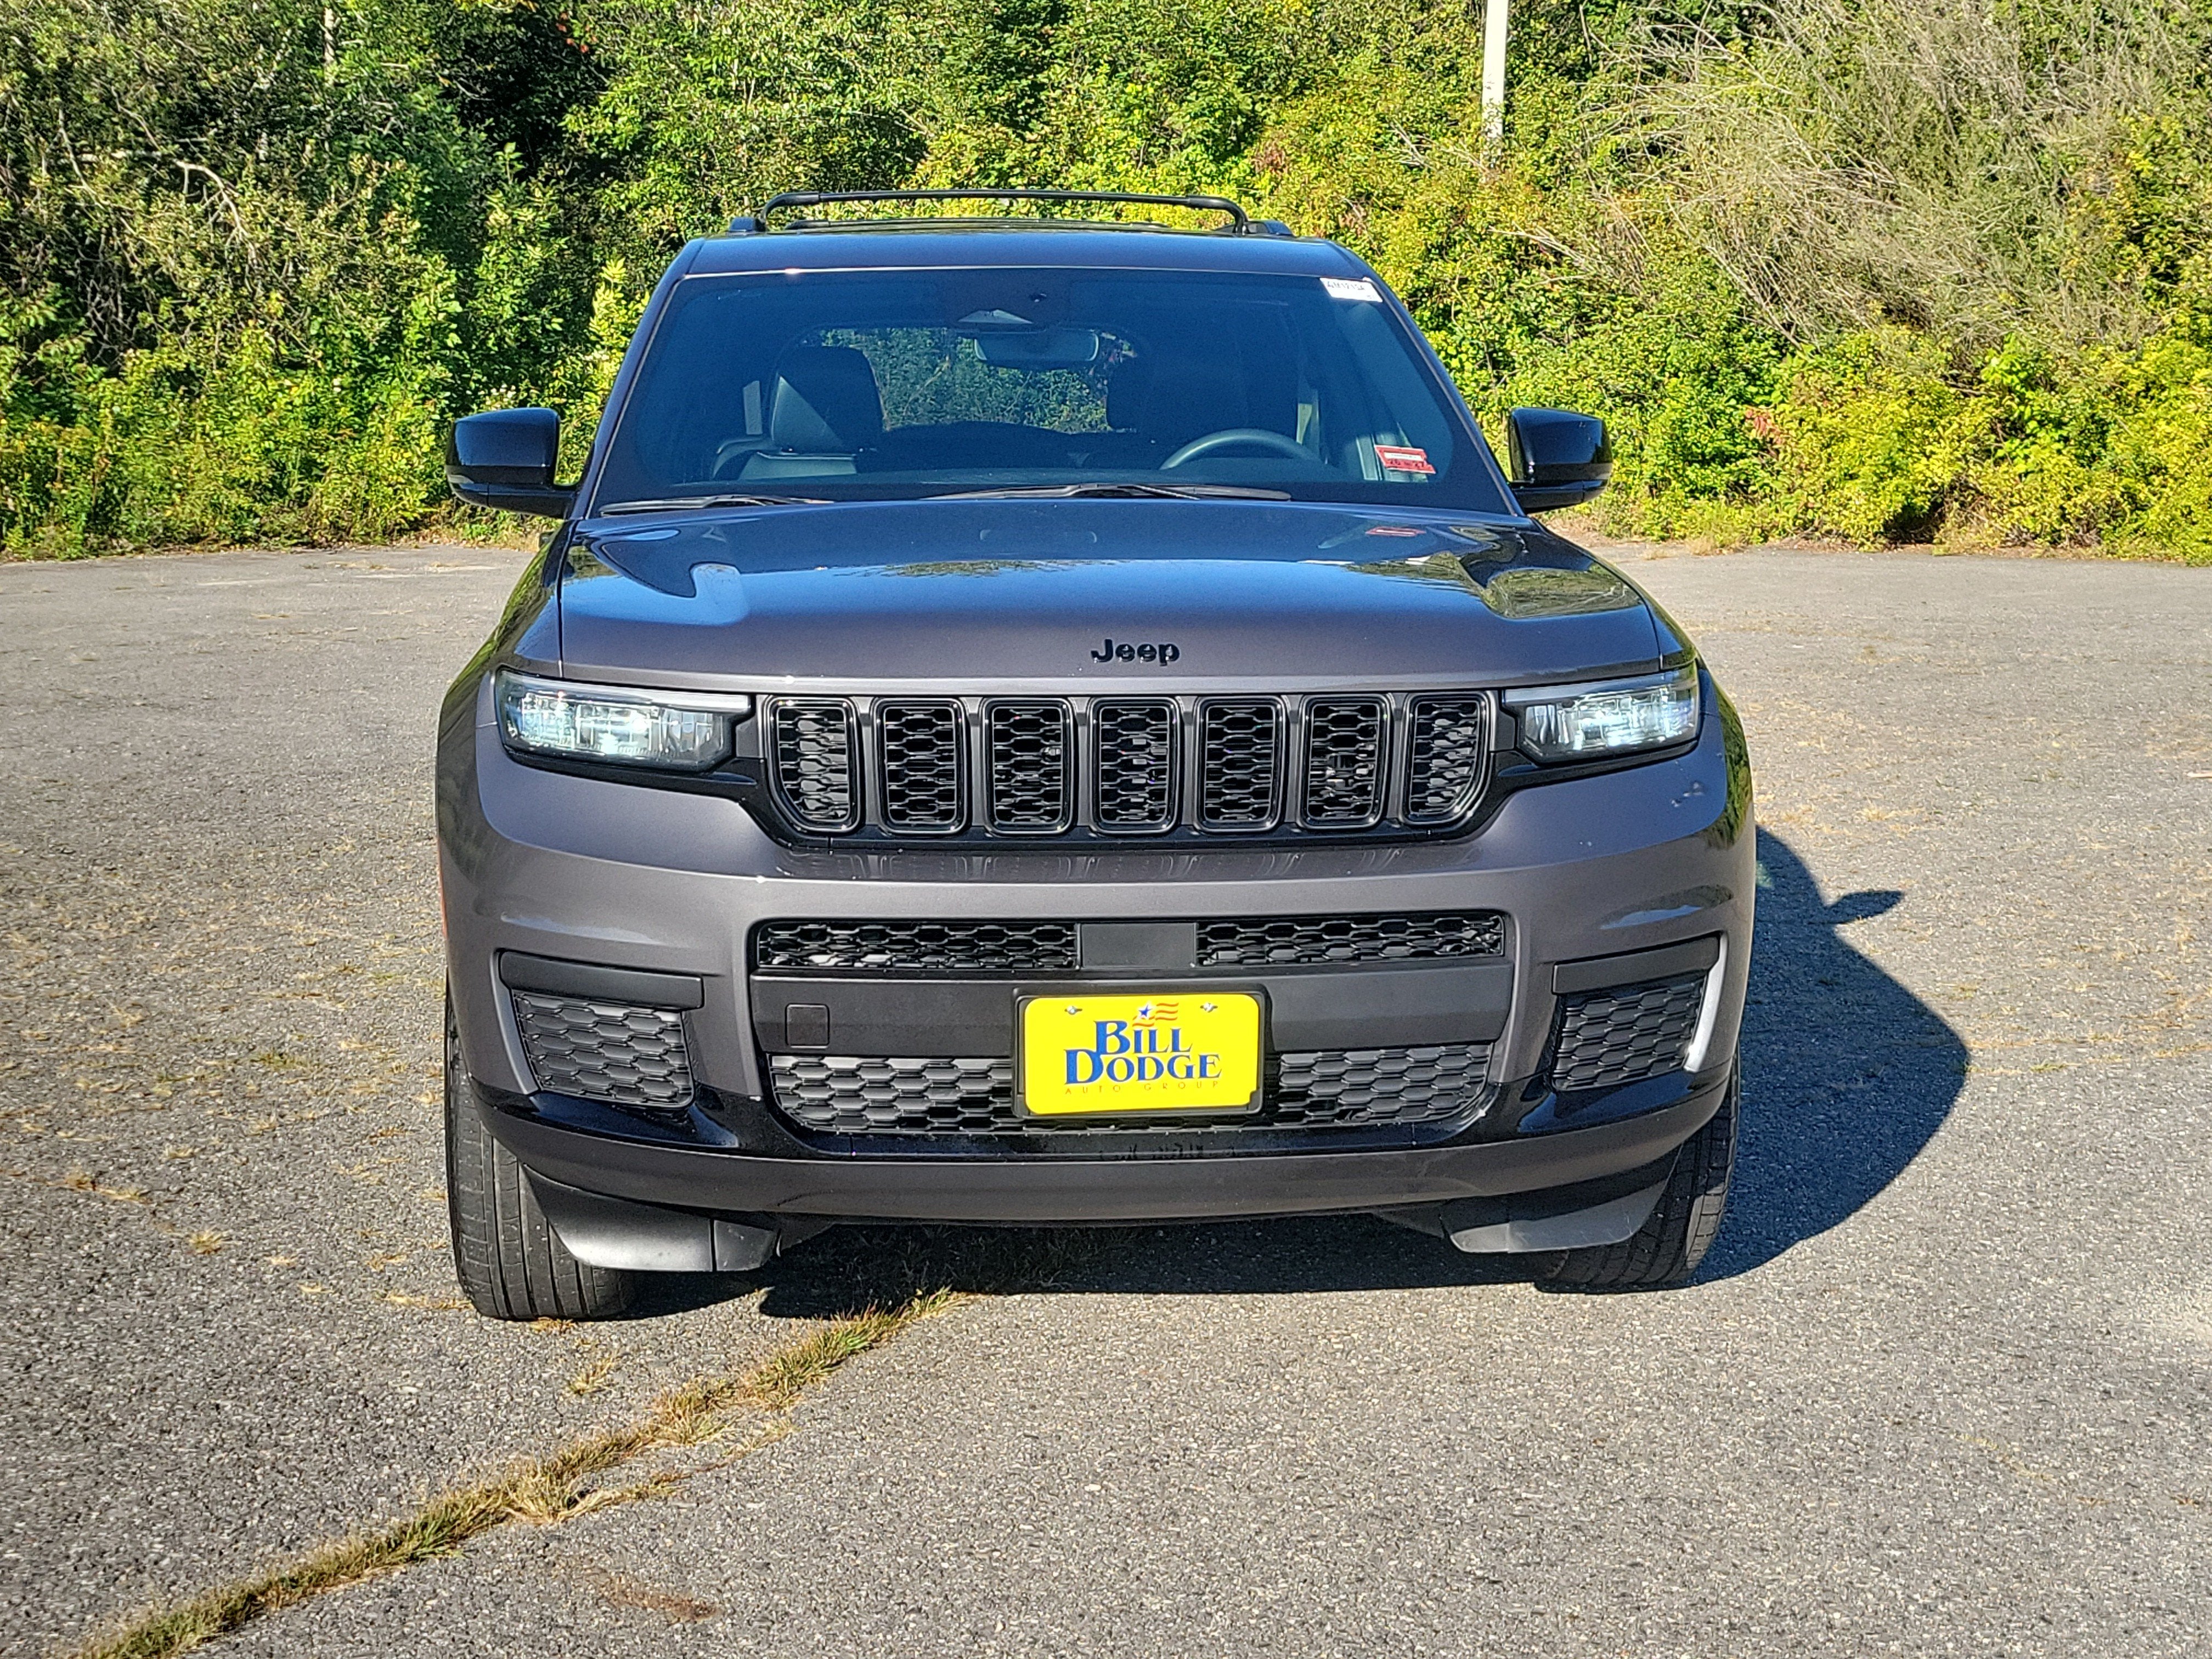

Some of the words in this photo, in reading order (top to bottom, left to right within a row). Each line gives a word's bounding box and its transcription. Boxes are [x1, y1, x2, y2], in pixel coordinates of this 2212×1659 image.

[1090, 639, 1180, 667] Jeep
[1093, 1020, 1193, 1055] BILL
[1063, 1048, 1222, 1085] DODGE
[1065, 1085, 1121, 1095] AUTO
[1144, 1081, 1220, 1091] GROUP
